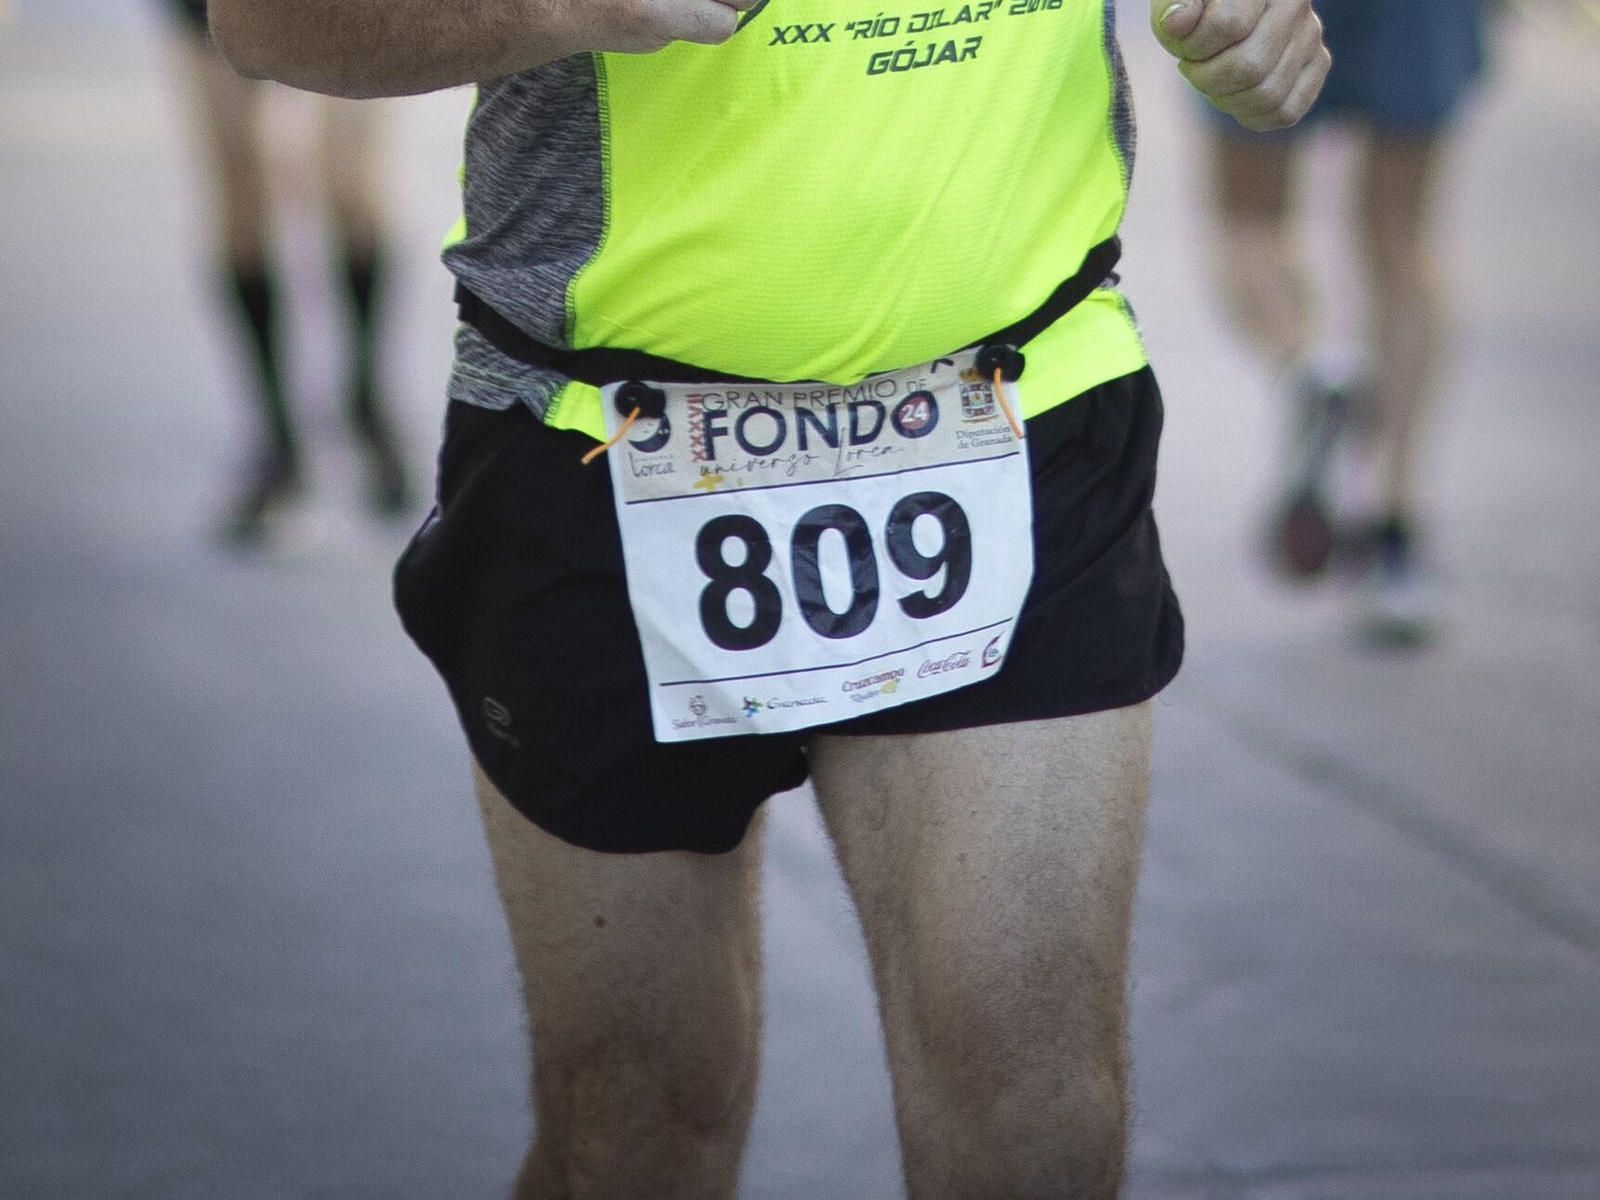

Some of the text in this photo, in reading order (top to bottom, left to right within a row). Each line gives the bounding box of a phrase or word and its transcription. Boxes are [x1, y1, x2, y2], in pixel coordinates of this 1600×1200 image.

[767, 22, 836, 46] XXX
[866, 35, 983, 76] GÓJAR
[701, 377, 929, 412] GRAN PREMIO DE
[900, 401, 931, 424] 24
[955, 425, 1011, 441] Diputación
[957, 435, 1013, 450] de Granada
[695, 490, 973, 652] 809
[841, 668, 905, 693] Cruzcampo
